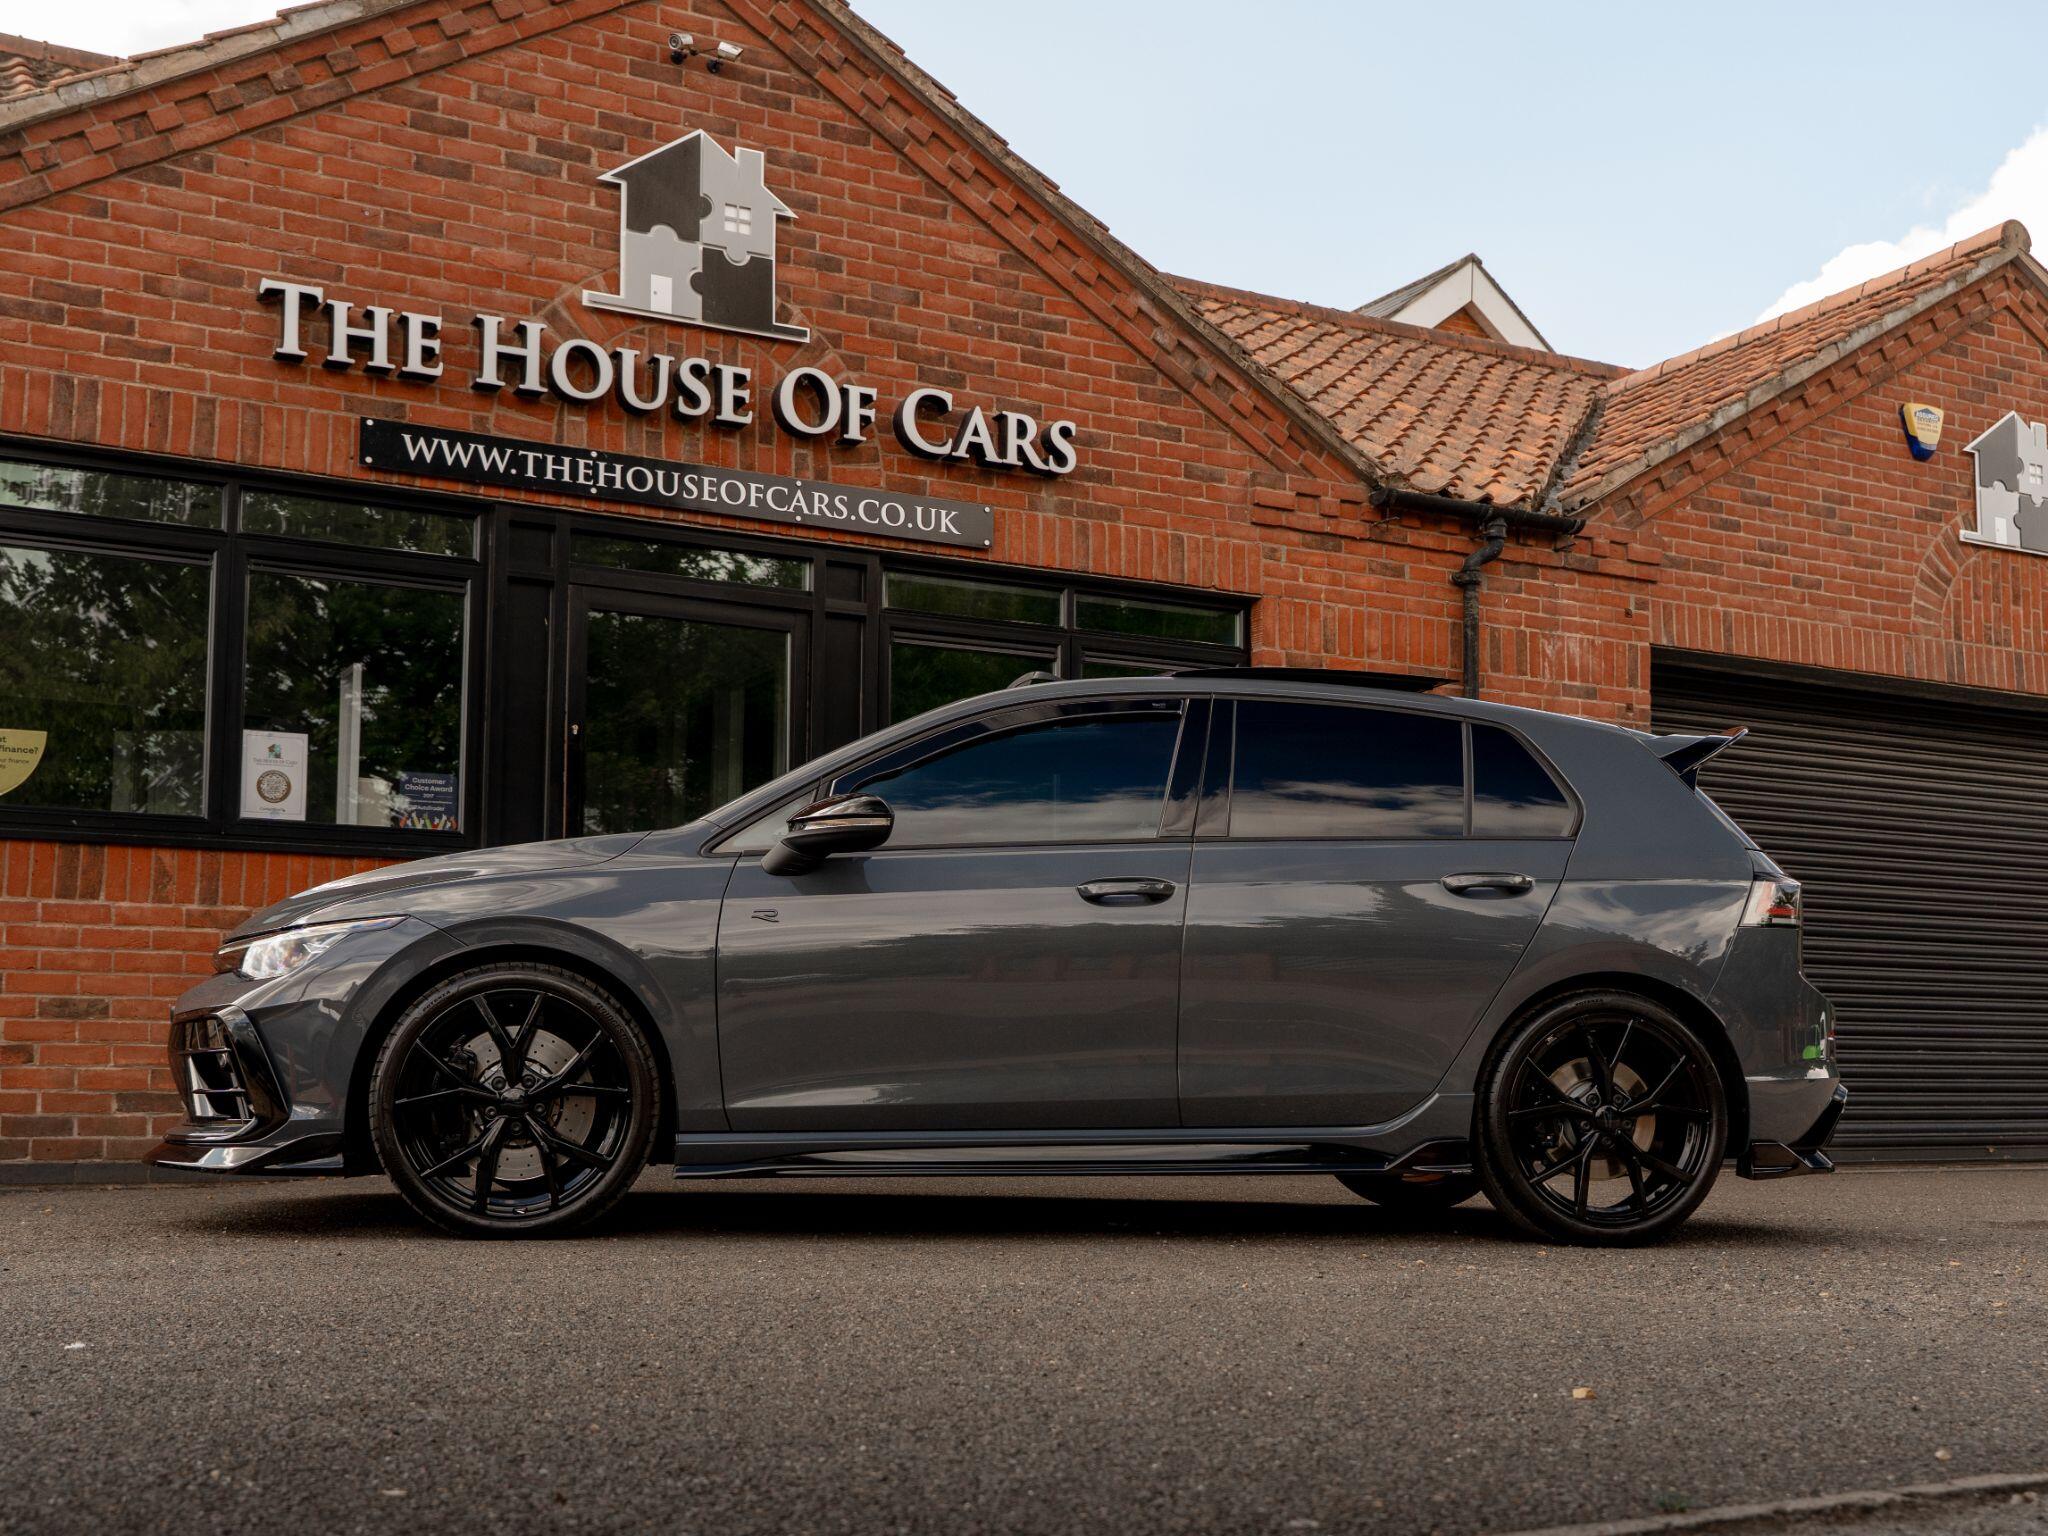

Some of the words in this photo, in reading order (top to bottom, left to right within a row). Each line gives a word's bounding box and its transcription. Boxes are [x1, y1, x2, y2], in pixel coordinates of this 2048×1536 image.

[258, 277, 444, 381] THE
[473, 313, 754, 430] HOUSE
[775, 366, 878, 443] OF
[899, 387, 1077, 476] CARS
[401, 433, 962, 536] WWW.THEHOUSEOFCARS.CO.UK
[404, 783, 429, 792] Choice
[430, 785, 453, 793] Award
[412, 777, 446, 785] Customer
